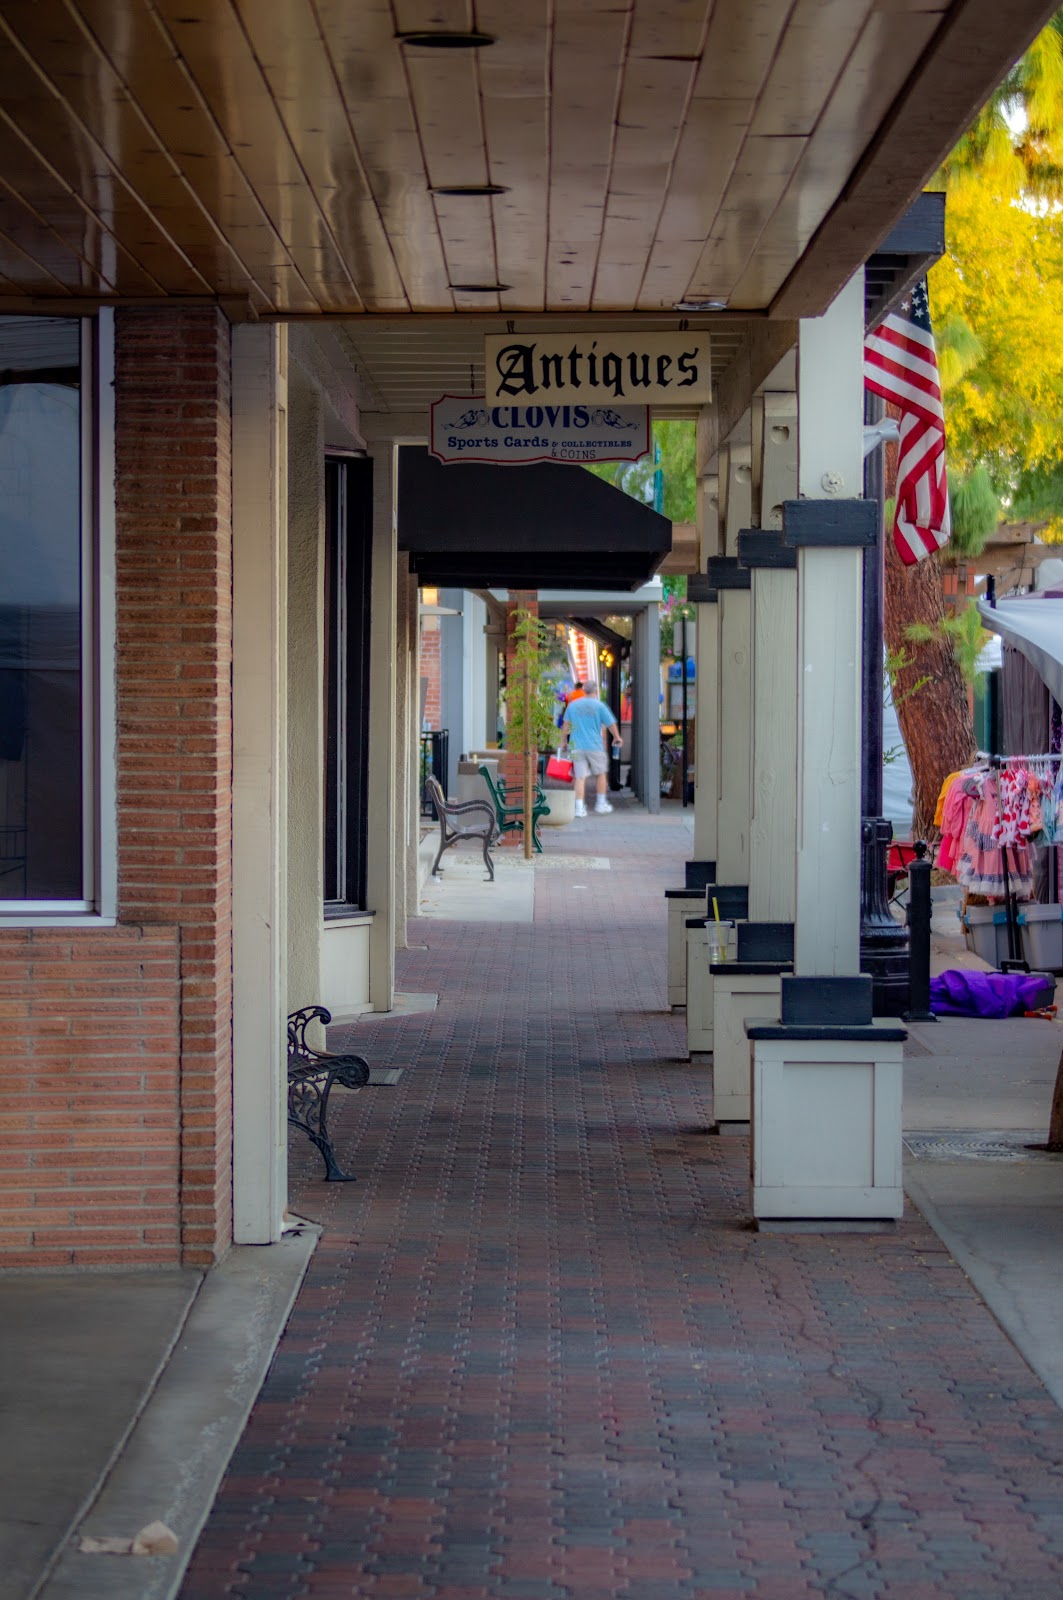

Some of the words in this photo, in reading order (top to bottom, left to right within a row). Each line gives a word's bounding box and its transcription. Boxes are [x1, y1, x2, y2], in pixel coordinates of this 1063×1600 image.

[496, 341, 699, 398] Antiques
[492, 405, 590, 428] CLOVIS
[447, 436, 498, 450] Sports
[504, 436, 549, 447] Cards
[551, 448, 558, 457] &
[560, 449, 596, 459] COINS
